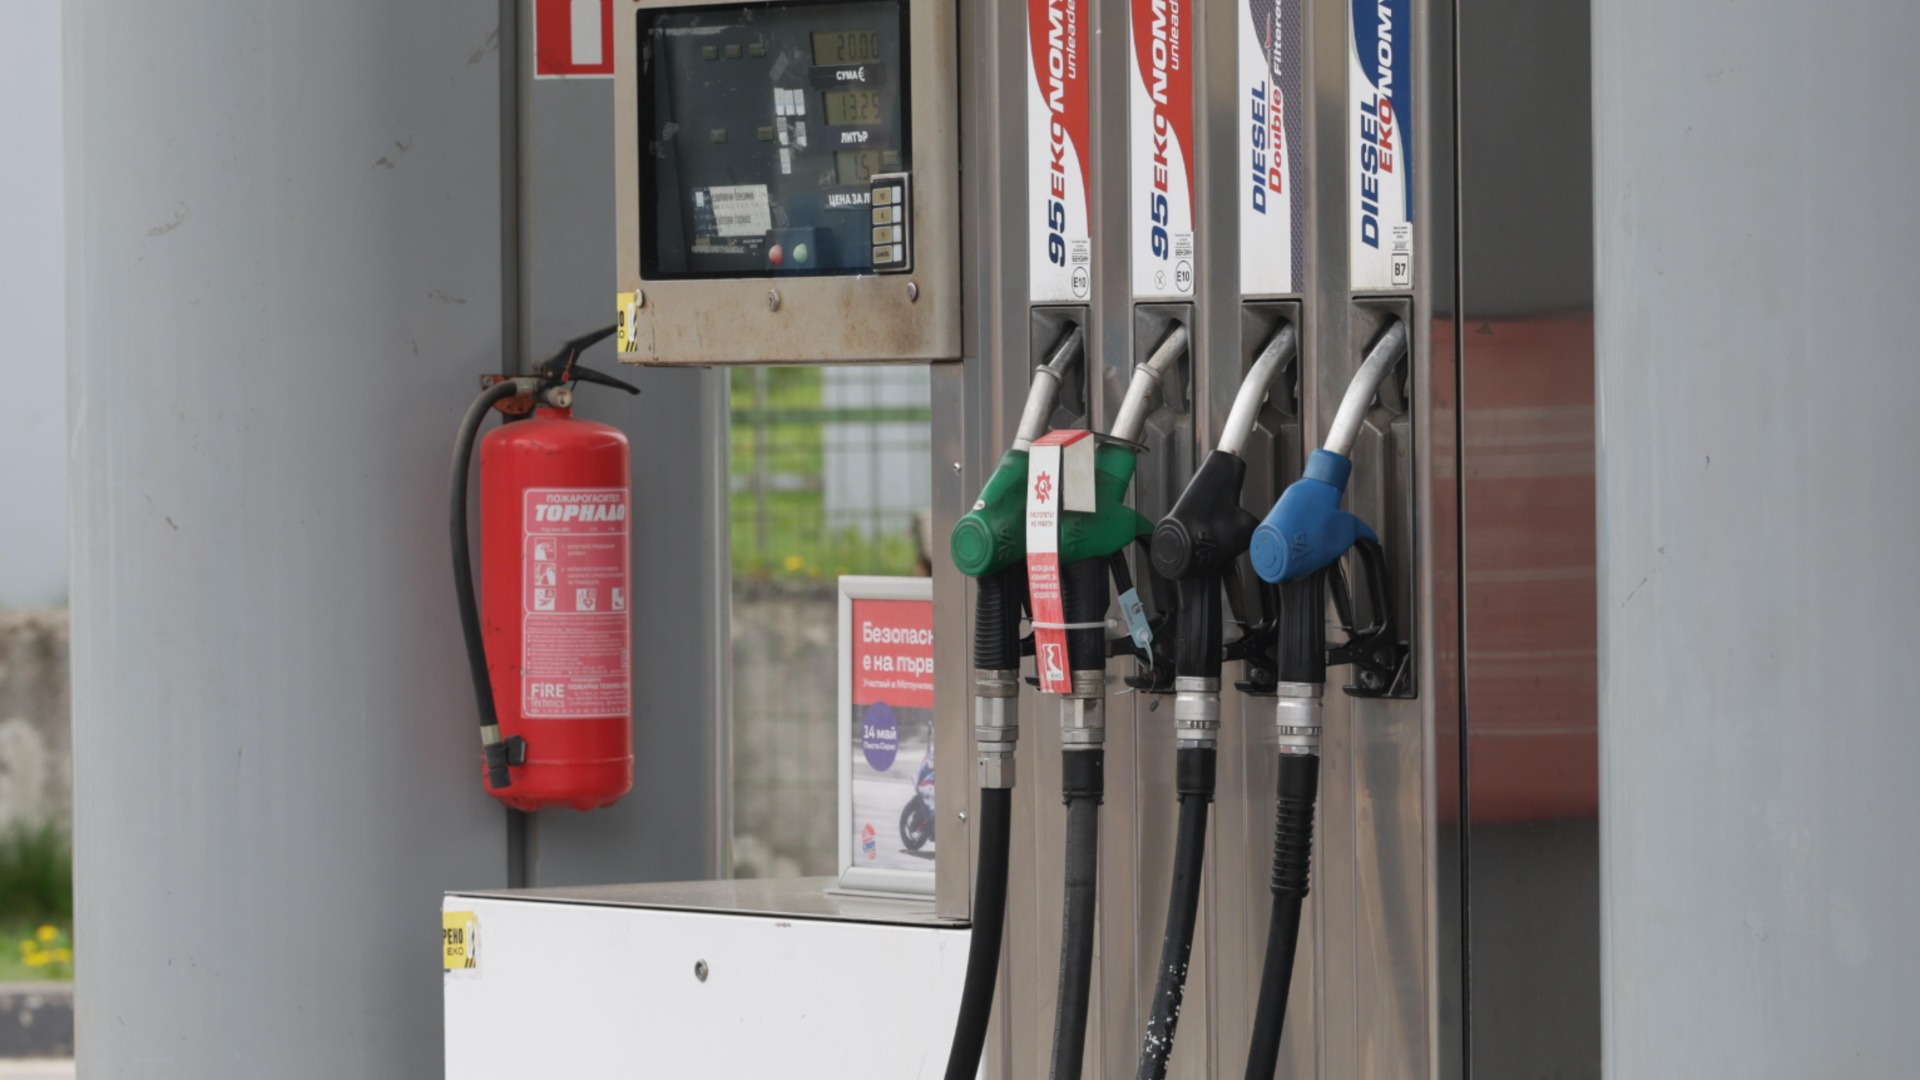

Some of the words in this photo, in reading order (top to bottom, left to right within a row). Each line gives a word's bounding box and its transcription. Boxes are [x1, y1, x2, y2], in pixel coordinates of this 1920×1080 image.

[1378, 0, 1393, 173] EKONOM
[841, 131, 869, 143] ЛИТЪР
[1269, 89, 1282, 195] Double
[1252, 81, 1266, 215] DIESEL
[1361, 93, 1379, 250] DIESEL
[828, 193, 851, 207] ЦЕНА
[852, 192, 863, 205] ЗА
[1177, 270, 1190, 282] E10
[1395, 263, 1406, 276] B7
[535, 504, 625, 522] ТОРНАДО
[863, 655, 871, 671] е
[873, 655, 894, 671] на
[531, 682, 565, 698] FiRE
[863, 725, 875, 739] 14
[877, 726, 897, 740] май
[447, 947, 464, 956] EKO
